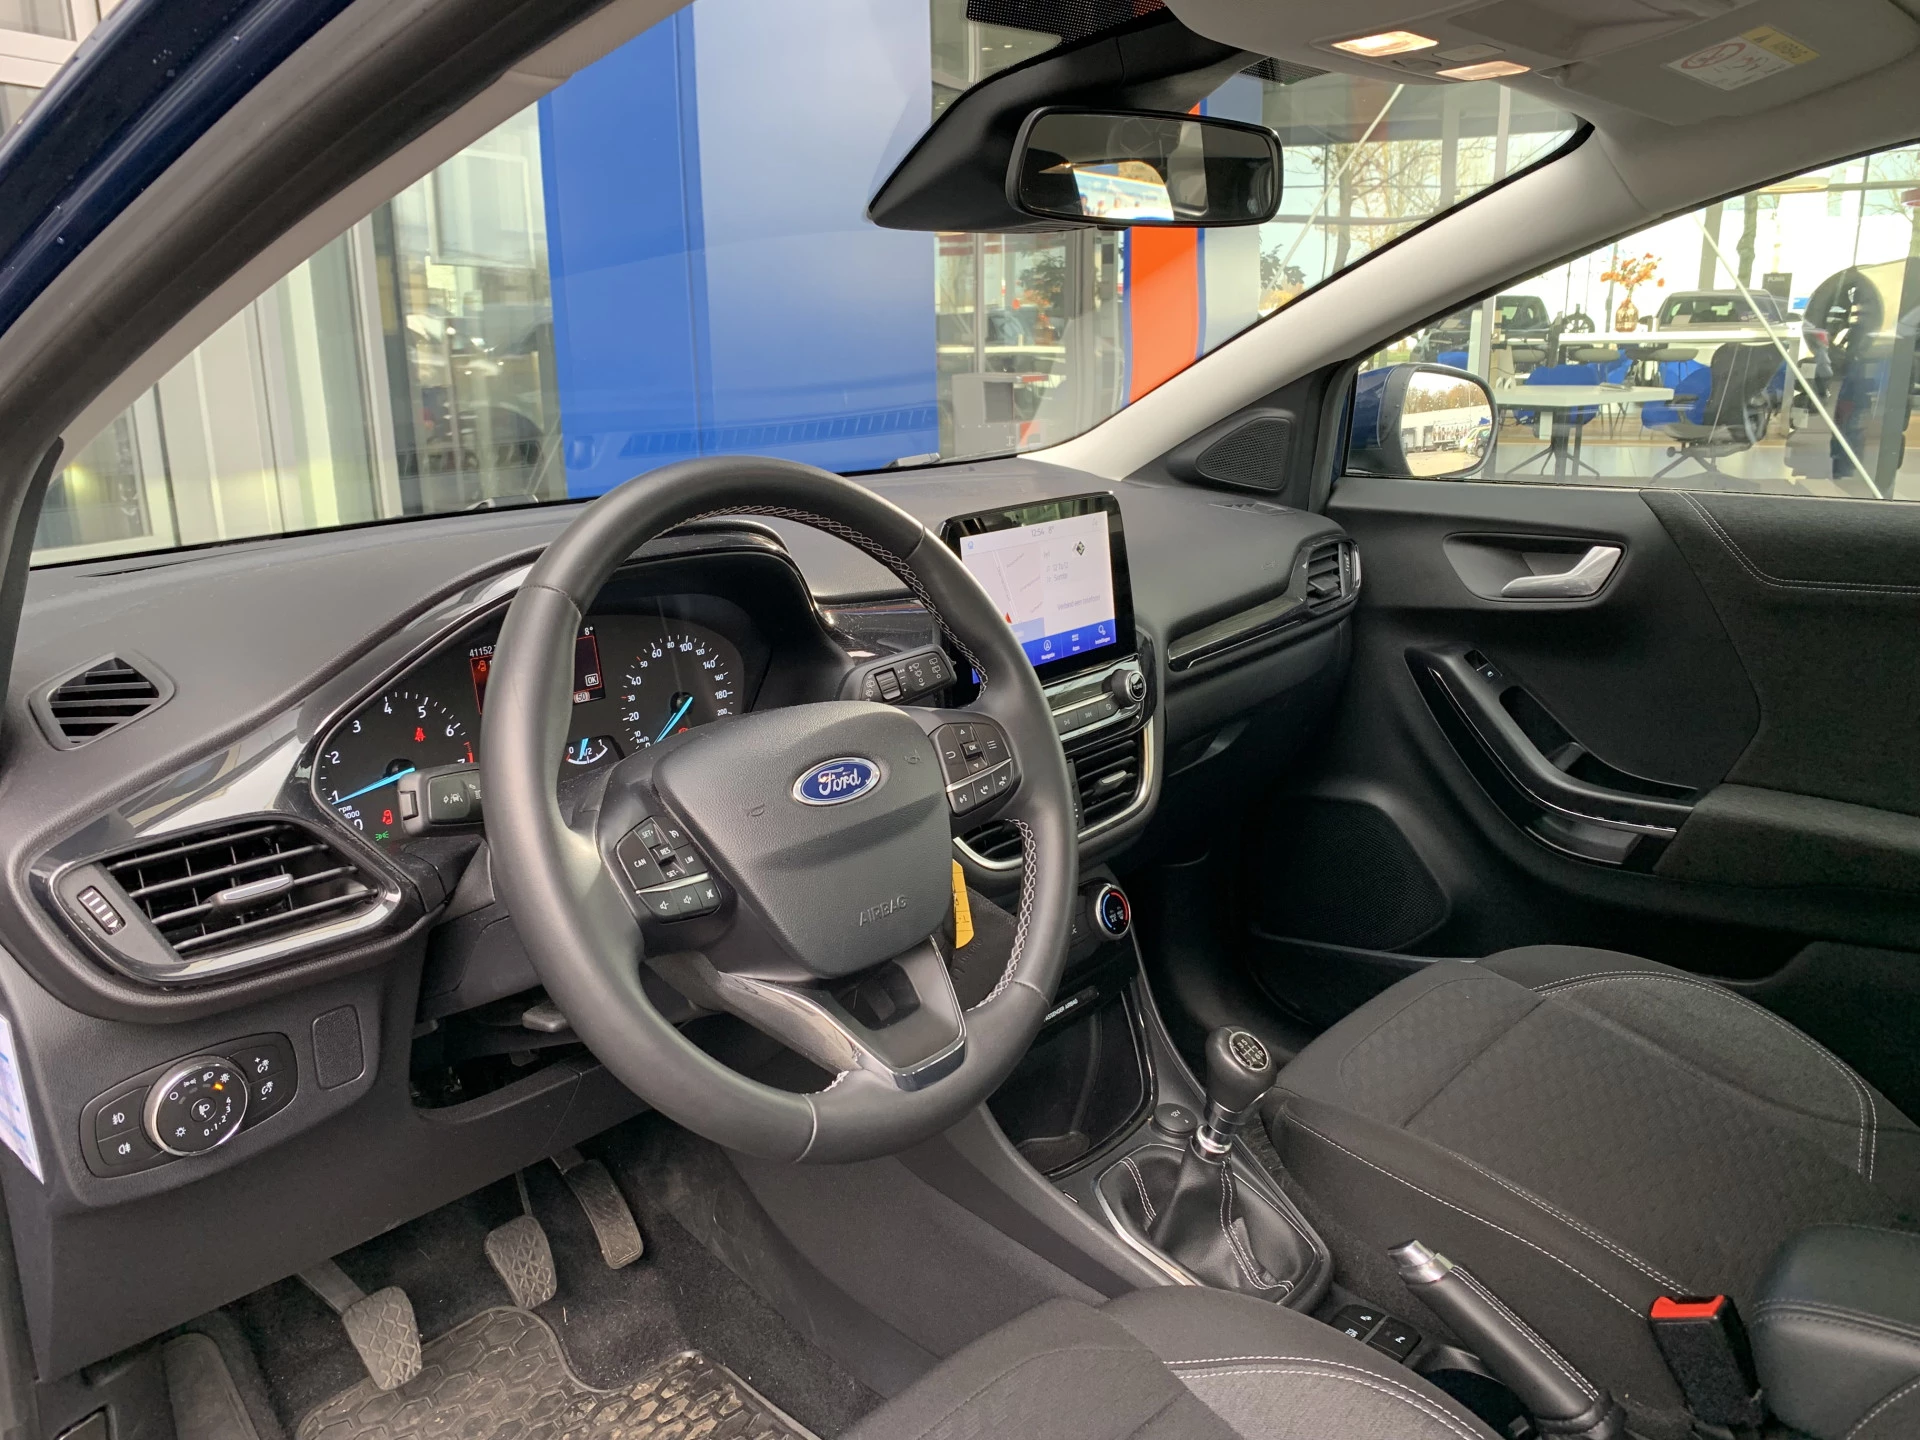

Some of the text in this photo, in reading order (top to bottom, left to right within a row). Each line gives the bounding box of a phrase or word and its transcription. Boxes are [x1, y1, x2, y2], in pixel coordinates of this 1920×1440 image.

[470, 646, 492, 658] 41152
[680, 642, 692, 652] 100
[652, 648, 662, 658] 60
[702, 660, 716, 670] 140
[588, 676, 597, 684] OK
[631, 676, 642, 686] 40
[577, 692, 587, 701] 50
[714, 690, 728, 700] 180
[384, 702, 392, 714] 4
[418, 705, 426, 718] 5
[717, 708, 728, 716] 200
[628, 711, 640, 722] 20
[352, 720, 362, 733] 3
[446, 724, 454, 736] 6
[634, 730, 642, 738] 10
[636, 736, 650, 744] km/h
[568, 746, 574, 754] 0
[330, 751, 340, 764] 2
[818, 766, 862, 796] Ford
[332, 790, 338, 801] 1
[338, 805, 352, 813] rpm
[642, 829, 654, 839] SET+
[660, 846, 671, 856] RES
[634, 858, 647, 868] CAN
[684, 856, 694, 864] LIM
[666, 869, 679, 878] SET-
[860, 894, 907, 927] AIRBAG
[204, 1128, 210, 1136] 0
